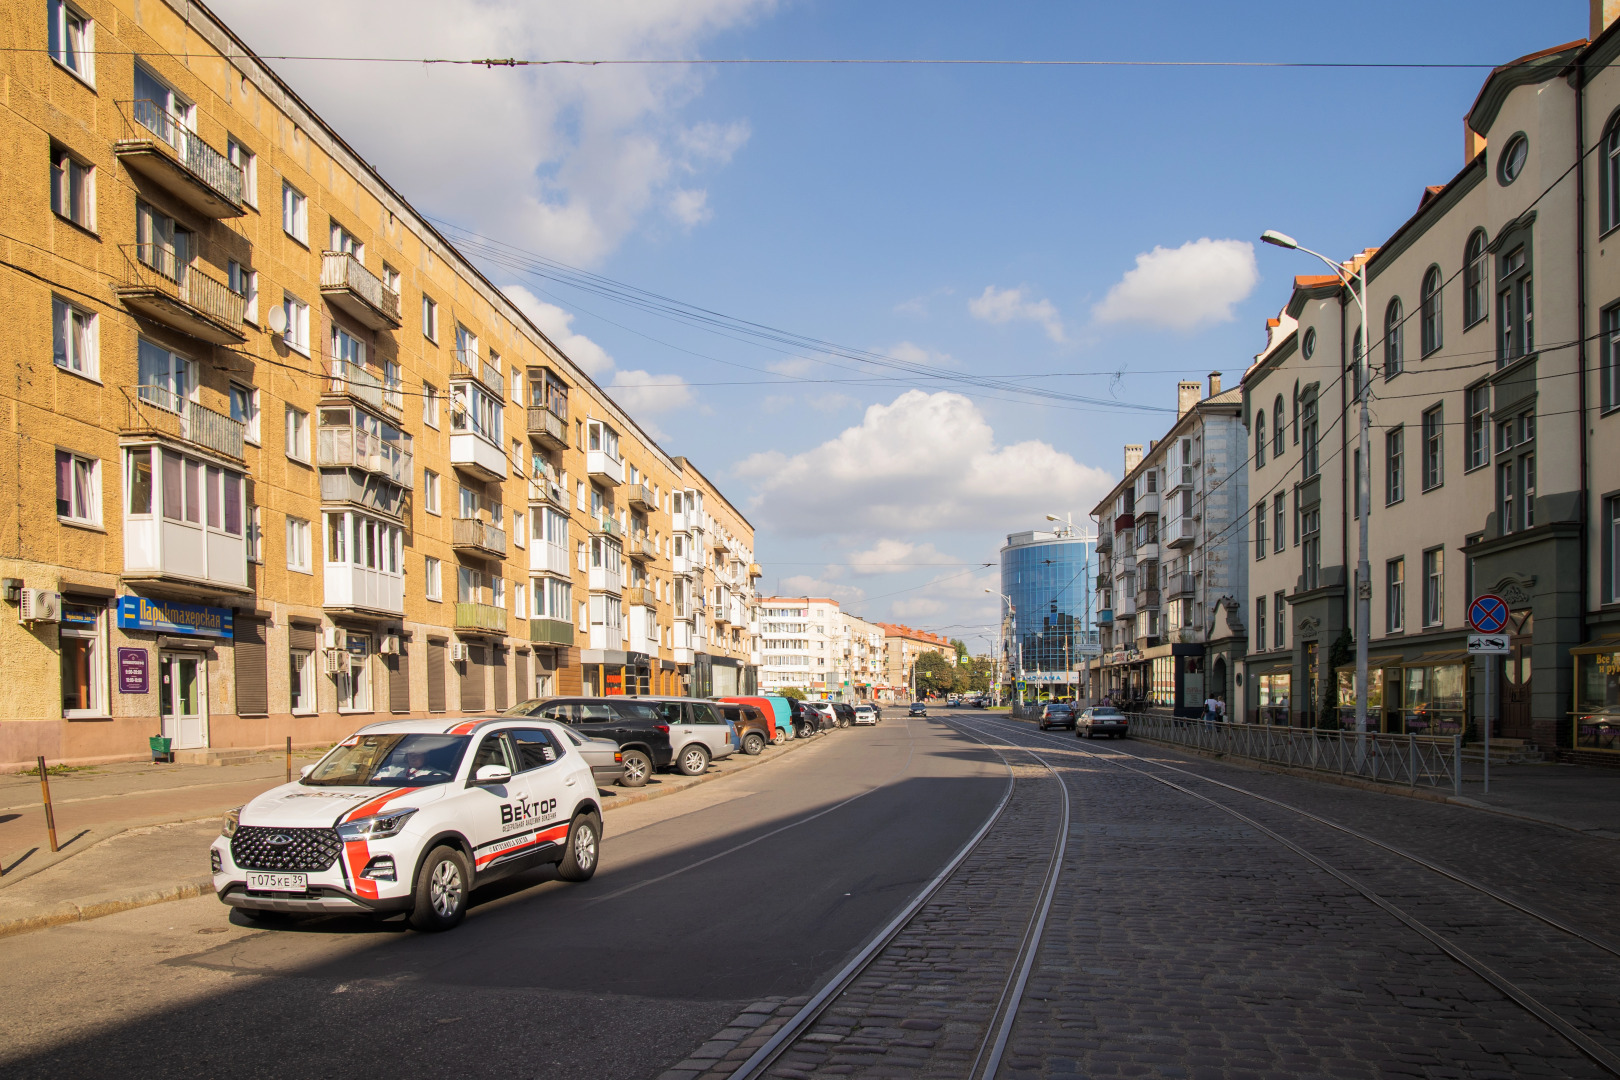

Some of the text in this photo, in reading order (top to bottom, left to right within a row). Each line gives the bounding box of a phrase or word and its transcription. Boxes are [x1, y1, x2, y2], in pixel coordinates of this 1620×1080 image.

[140, 599, 221, 631] Парикмахерская
[1596, 654, 1610, 664] Все
[292, 875, 303, 884] 39
